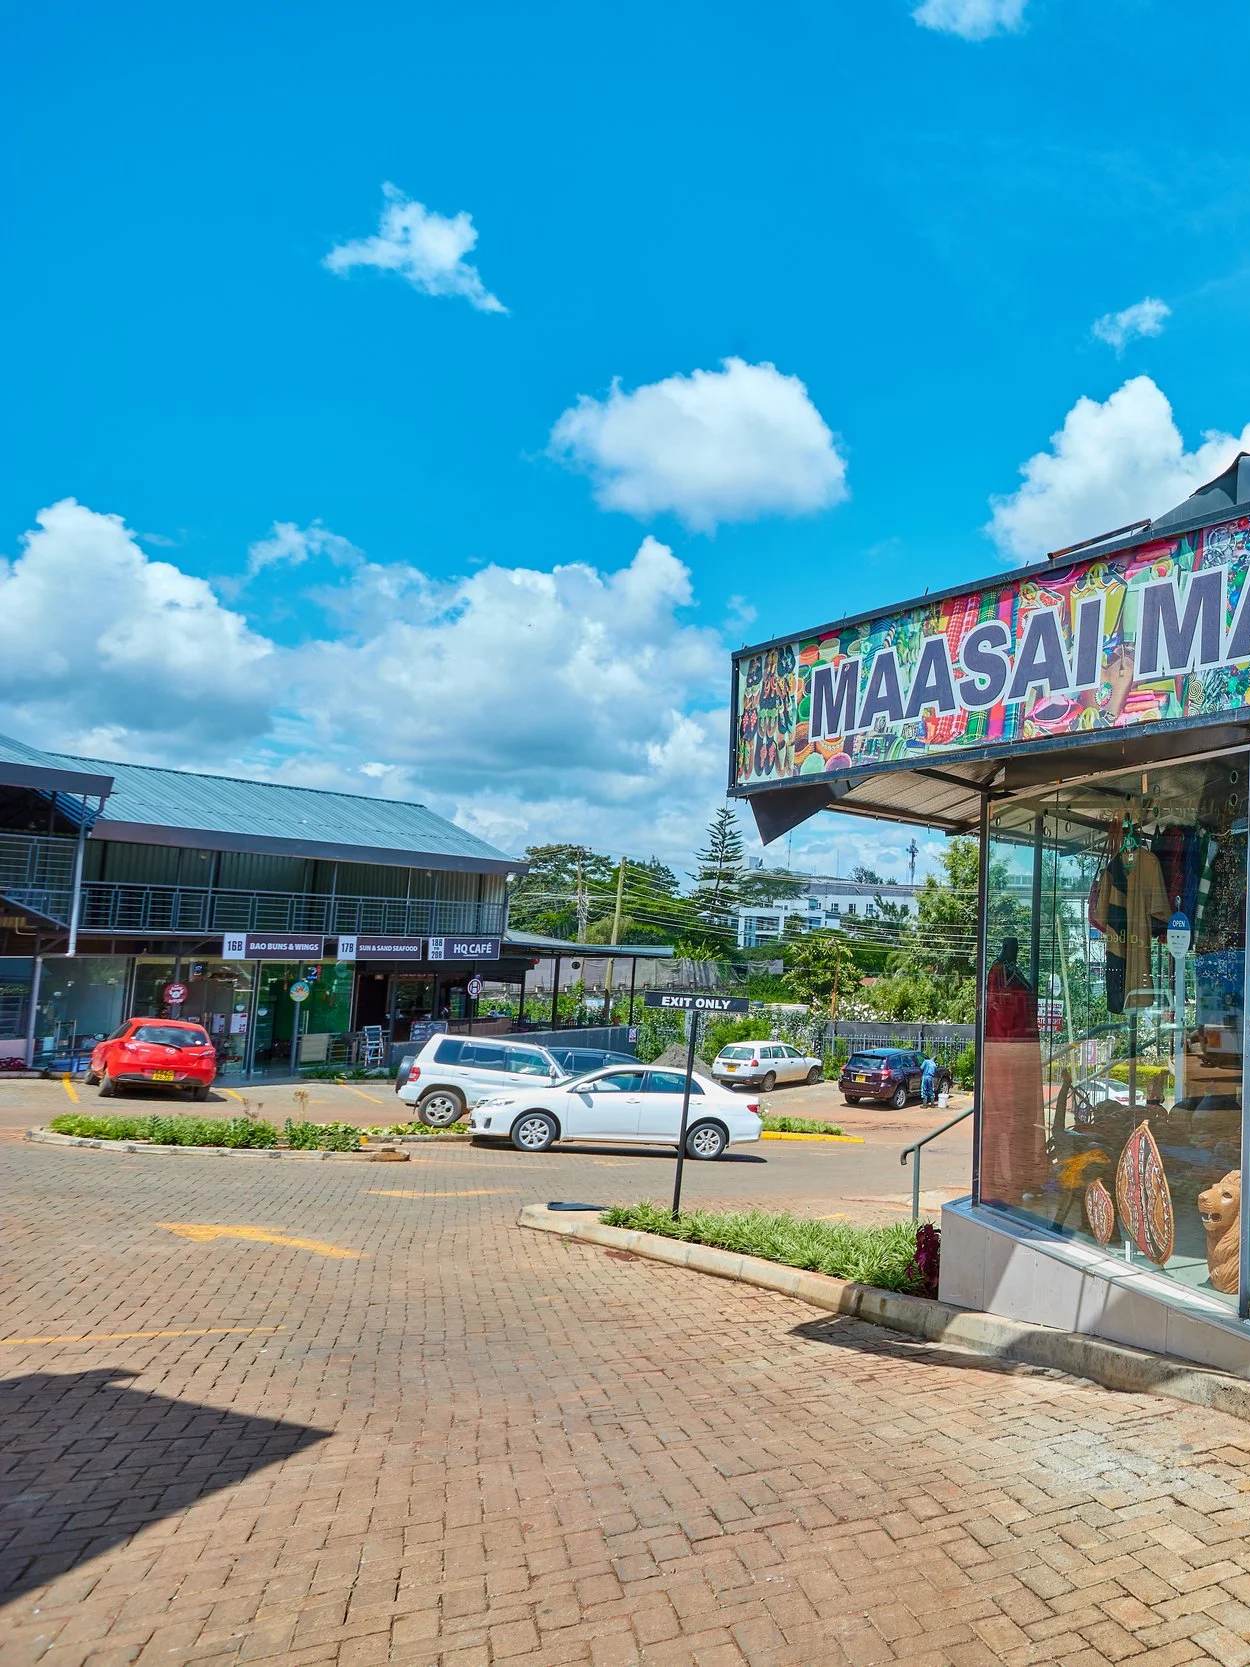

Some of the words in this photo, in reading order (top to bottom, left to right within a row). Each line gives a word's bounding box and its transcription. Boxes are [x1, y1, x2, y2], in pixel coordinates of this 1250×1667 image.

[810, 599, 1100, 739] MAASAI
[1172, 919, 1186, 928] OPEN
[228, 941, 243, 951] 16B
[288, 943, 294, 951] &
[294, 943, 319, 951] WINGS
[341, 942, 354, 953] 17B
[431, 938, 443, 947] 18B
[453, 943, 468, 954] HQ
[469, 941, 492, 954] CAFÉ
[661, 996, 693, 1007] EXIT
[695, 998, 732, 1010] ONLY
